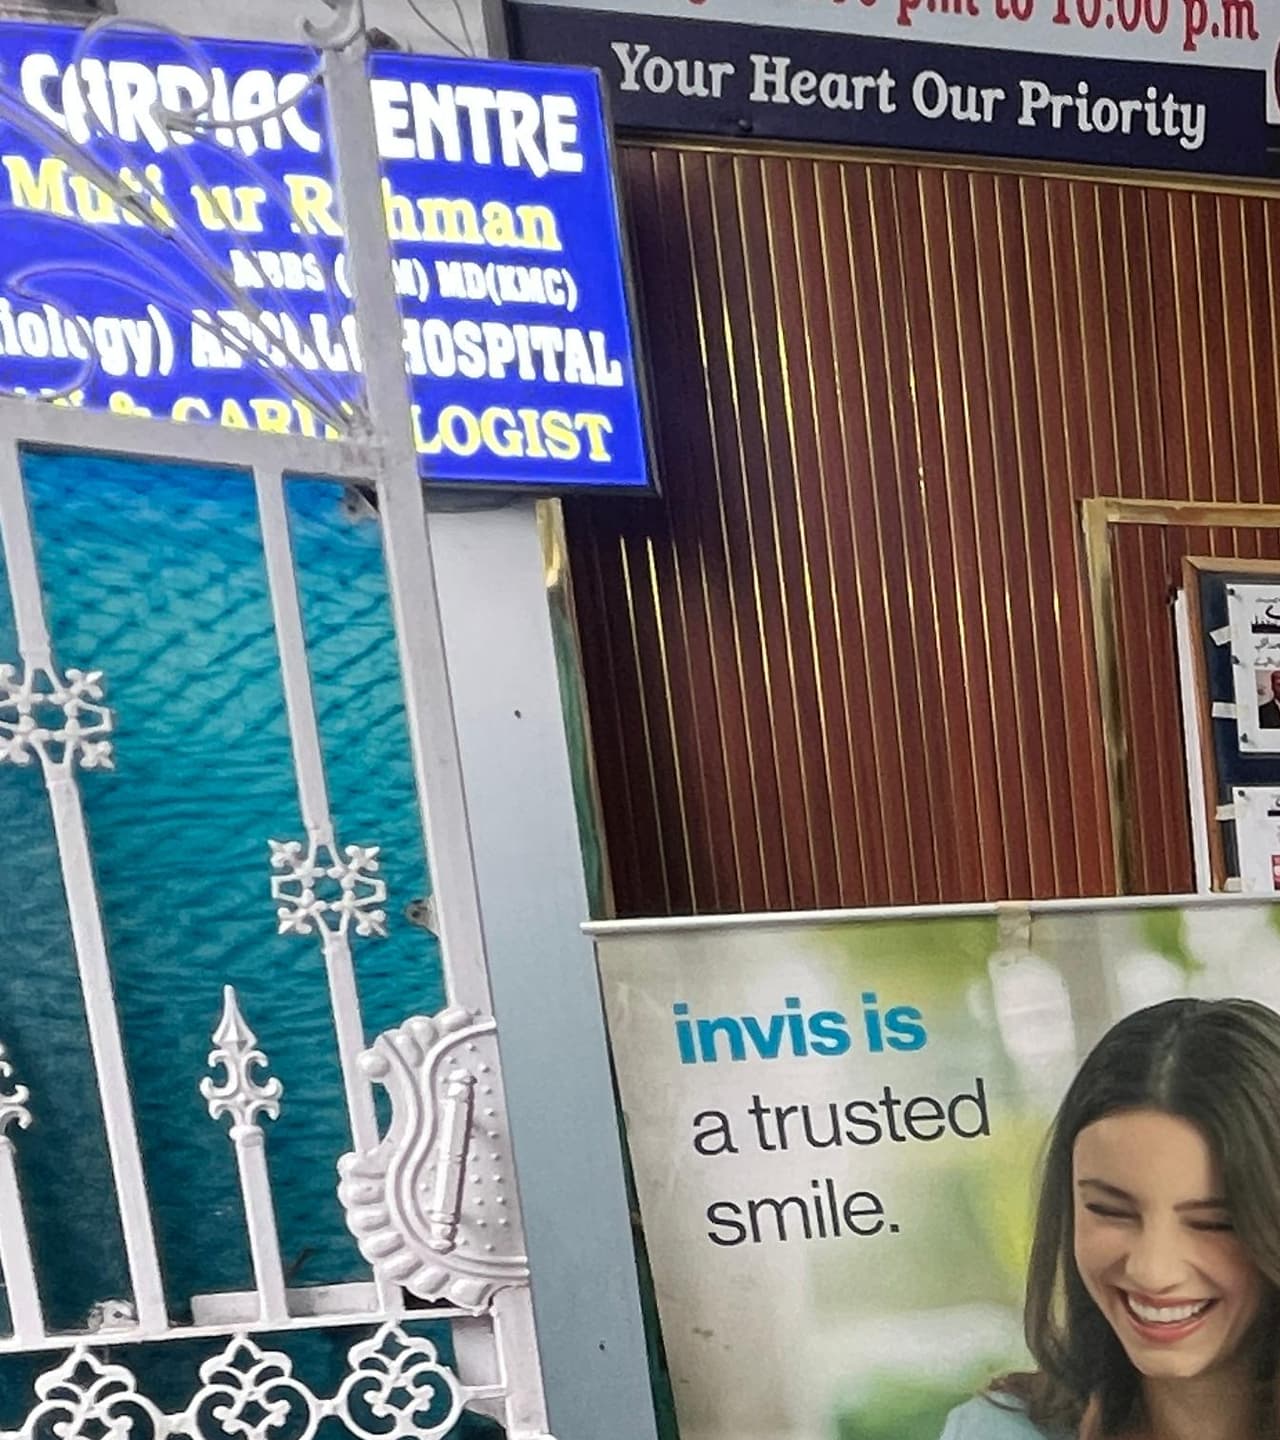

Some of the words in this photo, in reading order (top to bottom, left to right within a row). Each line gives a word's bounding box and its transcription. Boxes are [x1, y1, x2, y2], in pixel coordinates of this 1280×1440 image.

[370, 79, 584, 178] ENTRE
[611, 41, 735, 98] Your
[750, 53, 896, 114] Heart
[911, 69, 1006, 124] Our
[1018, 79, 1206, 151] Priority
[190, 186, 266, 232] ur
[283, 173, 562, 251] Rhman
[673, 997, 850, 1064] invis
[861, 991, 928, 1053] is
[692, 1110, 739, 1156] a
[747, 1077, 991, 1151] trusted
[706, 1178, 900, 1246] smile.
